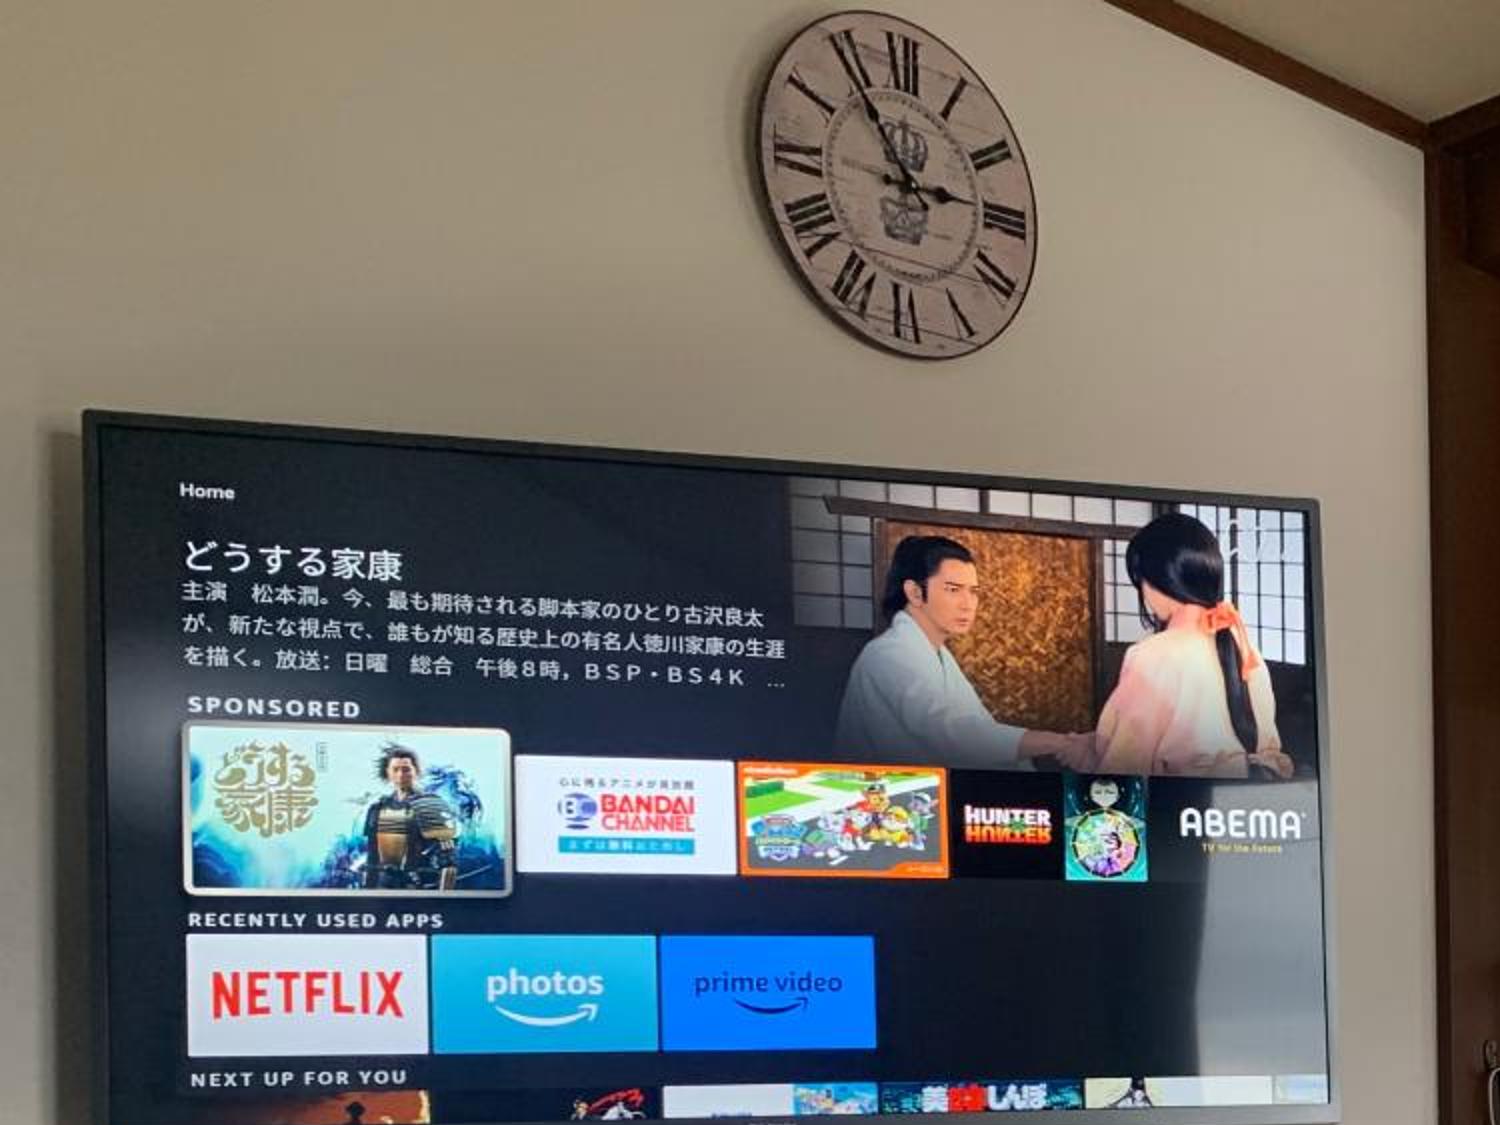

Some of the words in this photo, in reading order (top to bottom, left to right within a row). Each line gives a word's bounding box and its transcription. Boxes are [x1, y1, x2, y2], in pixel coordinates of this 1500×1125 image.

[179, 482, 235, 501] Home
[184, 541, 403, 580] どうする家康
[181, 580, 228, 602] 主演
[409, 654, 454, 676] 総合
[188, 695, 361, 718] SPONSORED
[601, 793, 695, 815] BANDAI
[601, 813, 696, 833] CHANNEL
[963, 804, 1052, 829] HUNTER
[1180, 806, 1302, 839] ABEMA
[188, 913, 307, 928] RECENTLY
[317, 913, 377, 928] USED
[386, 913, 444, 928] APPS
[212, 971, 404, 1019] NETFLIX
[486, 968, 604, 1002] photos
[694, 973, 767, 997] prime
[775, 972, 843, 993] video
[190, 1072, 253, 1087] NEXT
[263, 1072, 295, 1086] UP
[304, 1071, 350, 1085] FOR
[358, 1070, 407, 1085] YOU
